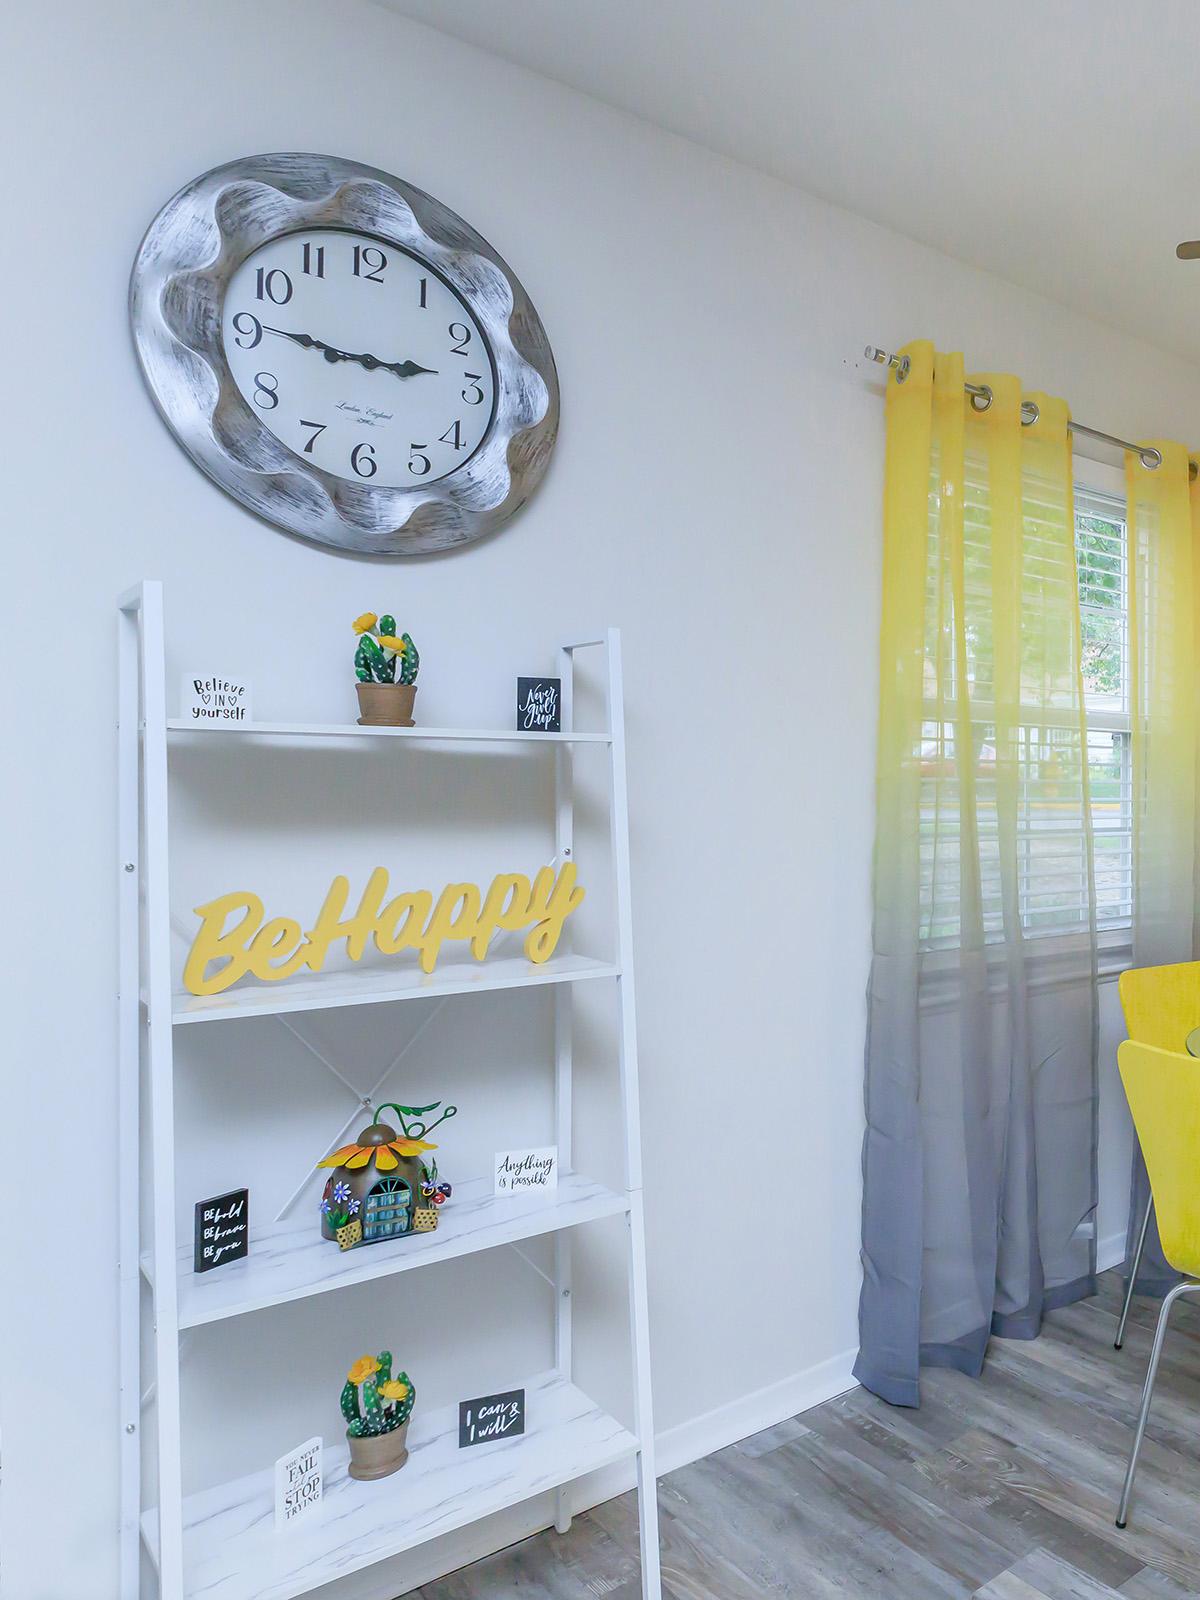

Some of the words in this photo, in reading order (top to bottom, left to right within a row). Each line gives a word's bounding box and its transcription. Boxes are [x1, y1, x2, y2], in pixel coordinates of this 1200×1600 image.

[301, 242, 326, 279] 11
[352, 244, 387, 284] 12
[254, 266, 293, 305] 10
[419, 278, 428, 309] 1
[232, 312, 263, 349] 9
[448, 322, 472, 356] 2
[253, 372, 279, 410] 8
[461, 372, 485, 406] 3
[299, 419, 328, 453] 7
[438, 420, 467, 451] 4
[350, 442, 378, 478] 6
[408, 444, 432, 475] 5
[193, 678, 245, 696] Believe
[215, 694, 225, 706] IN
[519, 683, 558, 711] Never
[192, 706, 246, 720] yourself
[524, 697, 552, 728] give
[497, 1154, 554, 1176] Anything
[499, 1175, 506, 1188] is
[511, 1172, 548, 1190] possible
[204, 1208, 215, 1222] BE
[214, 1200, 244, 1223] bold
[204, 1226, 215, 1240] BE
[214, 1225, 247, 1241] brave
[203, 1245, 215, 1258] BE
[213, 1241, 242, 1262] you
[466, 1410, 472, 1427] I
[478, 1403, 512, 1419] can
[509, 1402, 521, 1417] &
[470, 1424, 475, 1442] I
[478, 1415, 518, 1437] will
[289, 1456, 318, 1483] FAIL
[285, 1477, 320, 1510] STOP
[285, 1491, 320, 1519] TRYING
